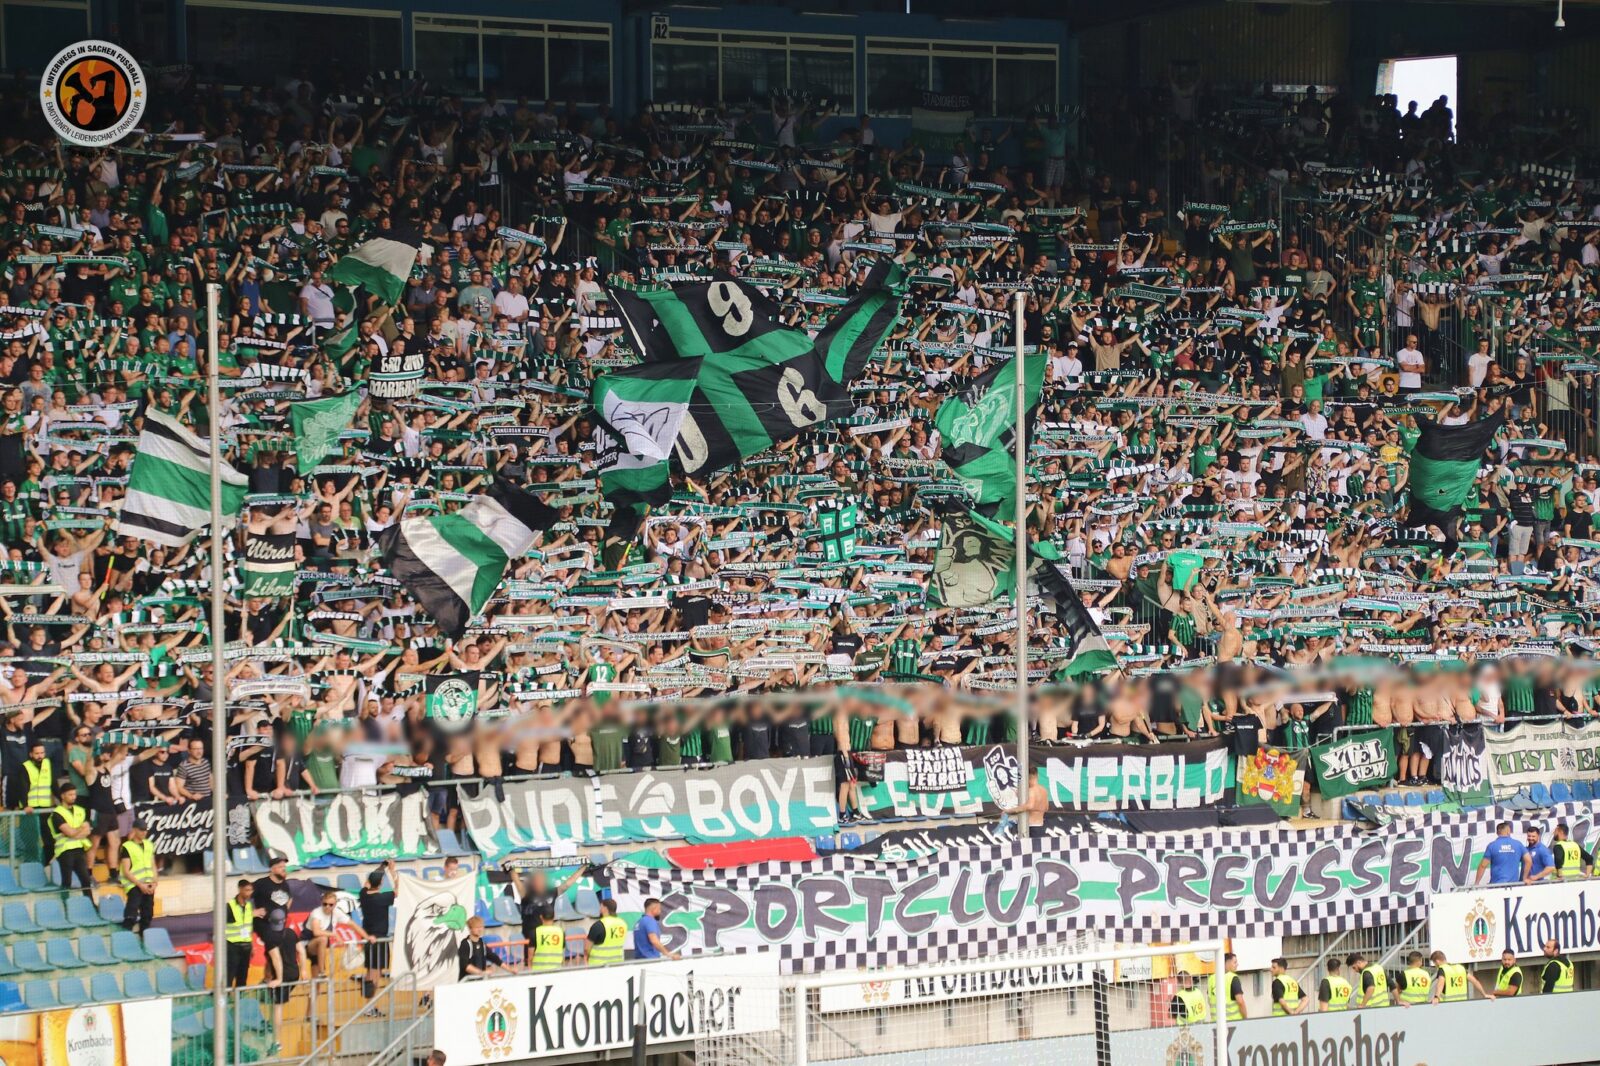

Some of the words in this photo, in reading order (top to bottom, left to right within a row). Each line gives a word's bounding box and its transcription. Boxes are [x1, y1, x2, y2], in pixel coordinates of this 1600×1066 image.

[654, 24, 668, 39] A2
[1225, 222, 1247, 231] RUDE
[1247, 222, 1267, 230] BOYS
[707, 281, 753, 337] 9
[777, 366, 827, 428] 6
[841, 512, 852, 527] C
[246, 538, 295, 560] Ultras
[827, 545, 837, 560] A
[595, 666, 608, 682] 12
[907, 758, 966, 774] STADION
[908, 770, 968, 786] VERBOT
[685, 766, 837, 839] BOYS
[138, 803, 214, 832] Preußen
[457, 782, 627, 860] RUDE
[657, 858, 1083, 954] SPORTCLUB
[1106, 834, 1474, 918] PREUSSEN
[540, 933, 560, 947] K9
[609, 926, 626, 940] K9
[1411, 976, 1428, 988] K9
[1450, 975, 1464, 988] K9
[1335, 986, 1350, 998] K9
[527, 969, 742, 1053] Krombacher
[67, 1034, 114, 1053] Krombacher
[1212, 1014, 1406, 1066] Krombacher
